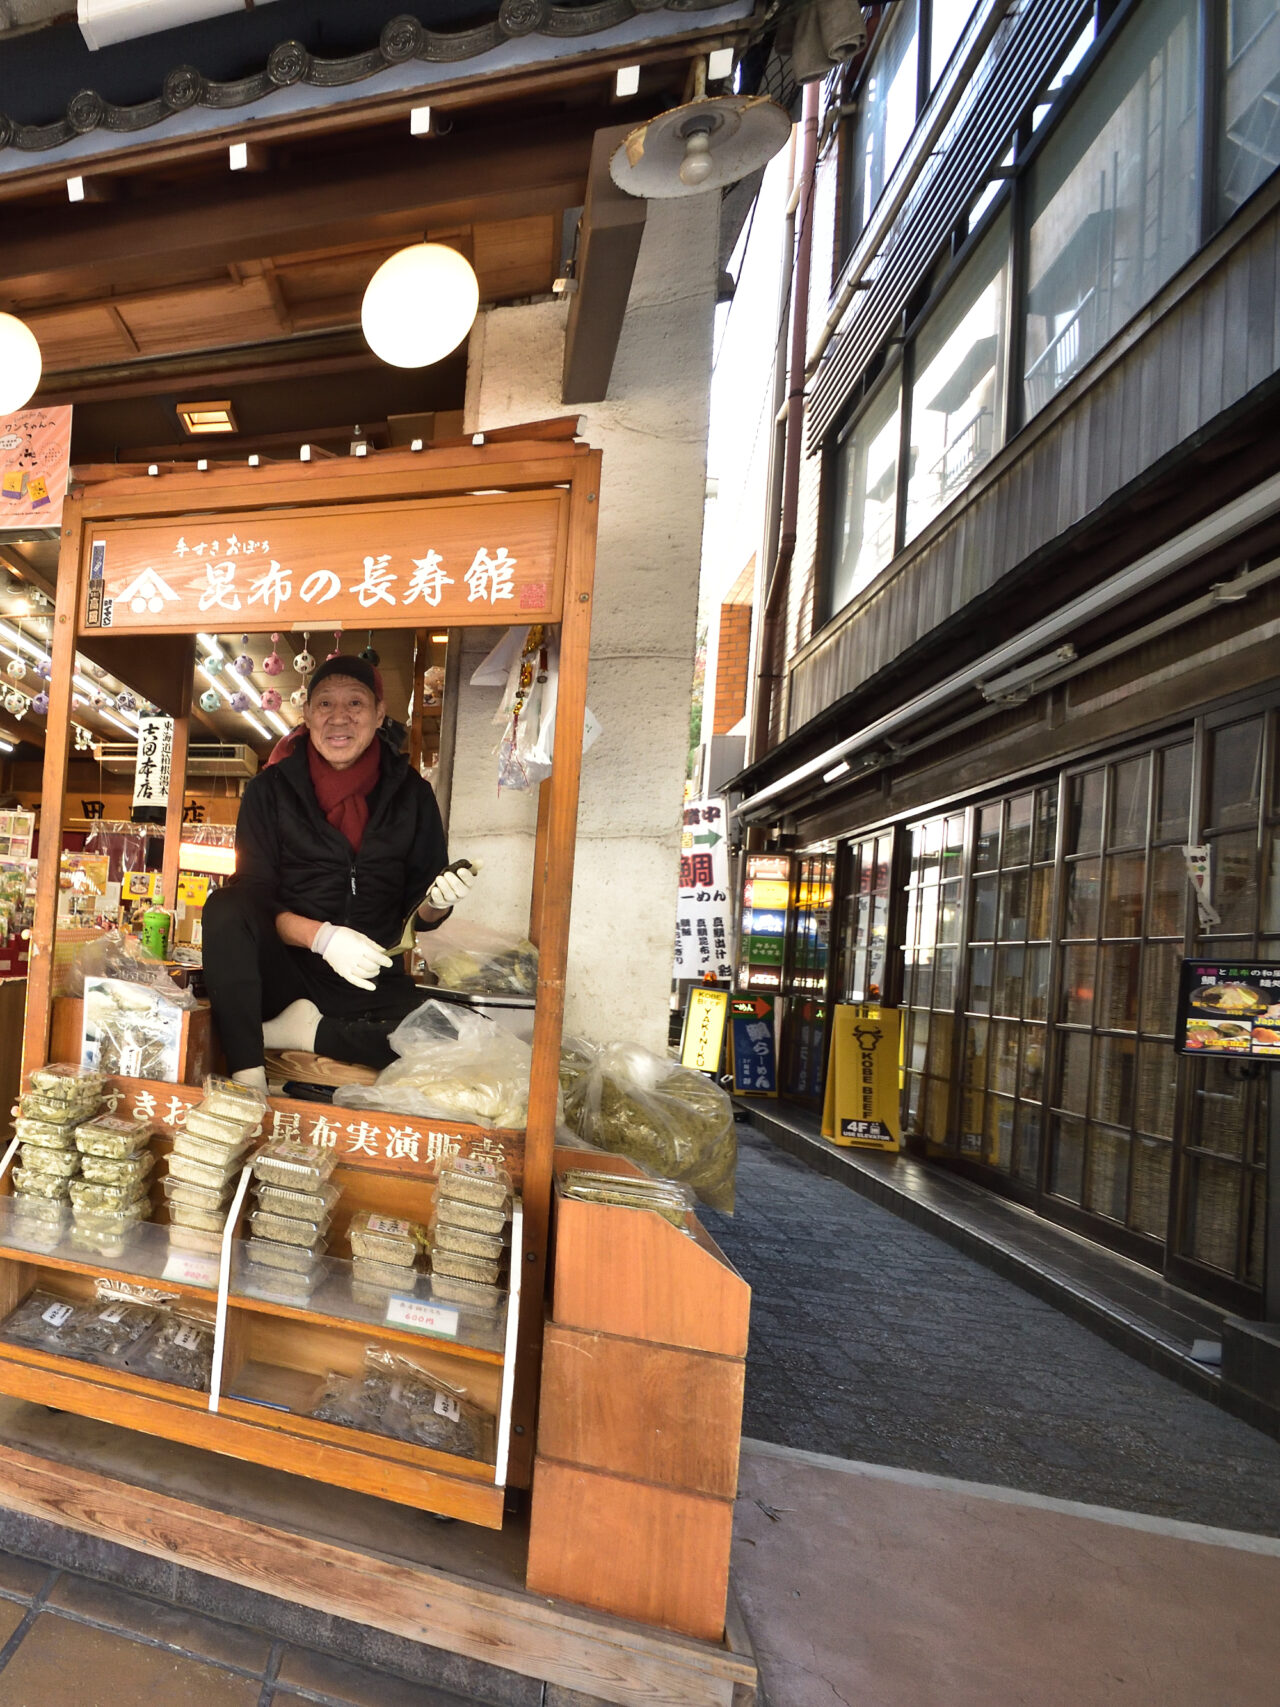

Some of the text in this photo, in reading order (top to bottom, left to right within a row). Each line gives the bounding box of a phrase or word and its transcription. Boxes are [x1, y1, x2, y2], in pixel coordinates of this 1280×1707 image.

[5, 420, 56, 432] ワンちゃんへ
[198, 546, 519, 613] 昆布の長寿館
[136, 722, 160, 799] 吉田本店
[159, 720, 173, 797] 東海道箱根湯本
[698, 991, 721, 1000] KOBE
[696, 1008, 712, 1067] YAKINIKU
[862, 1052, 873, 1119] KOBE BEEF
[846, 1121, 868, 1133] 4F
